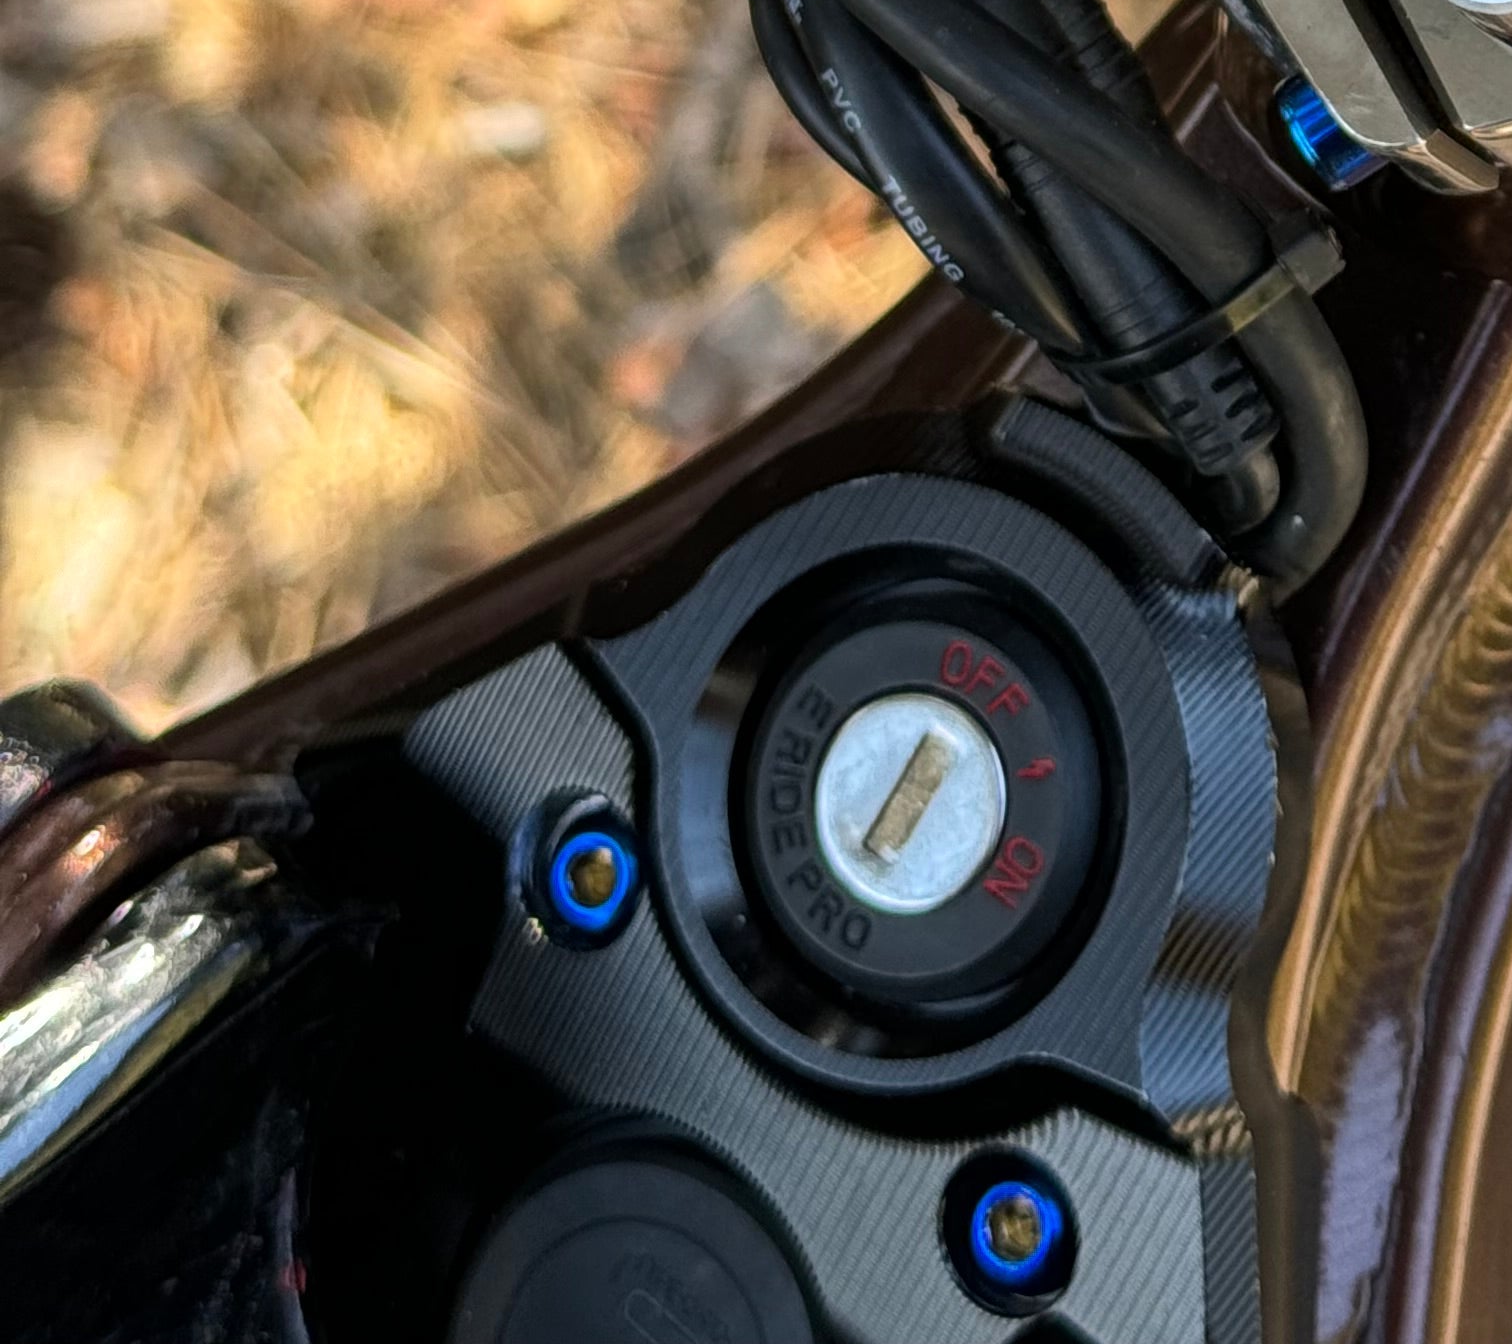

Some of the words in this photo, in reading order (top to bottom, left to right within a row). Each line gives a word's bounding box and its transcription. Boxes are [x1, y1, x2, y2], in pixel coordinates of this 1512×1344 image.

[821, 68, 862, 132] PVC
[882, 173, 965, 282] TUBING
[940, 639, 1029, 716] OFF
[770, 727, 815, 855] RIDE
[786, 858, 873, 952] PRO
[983, 835, 1044, 909] ON
